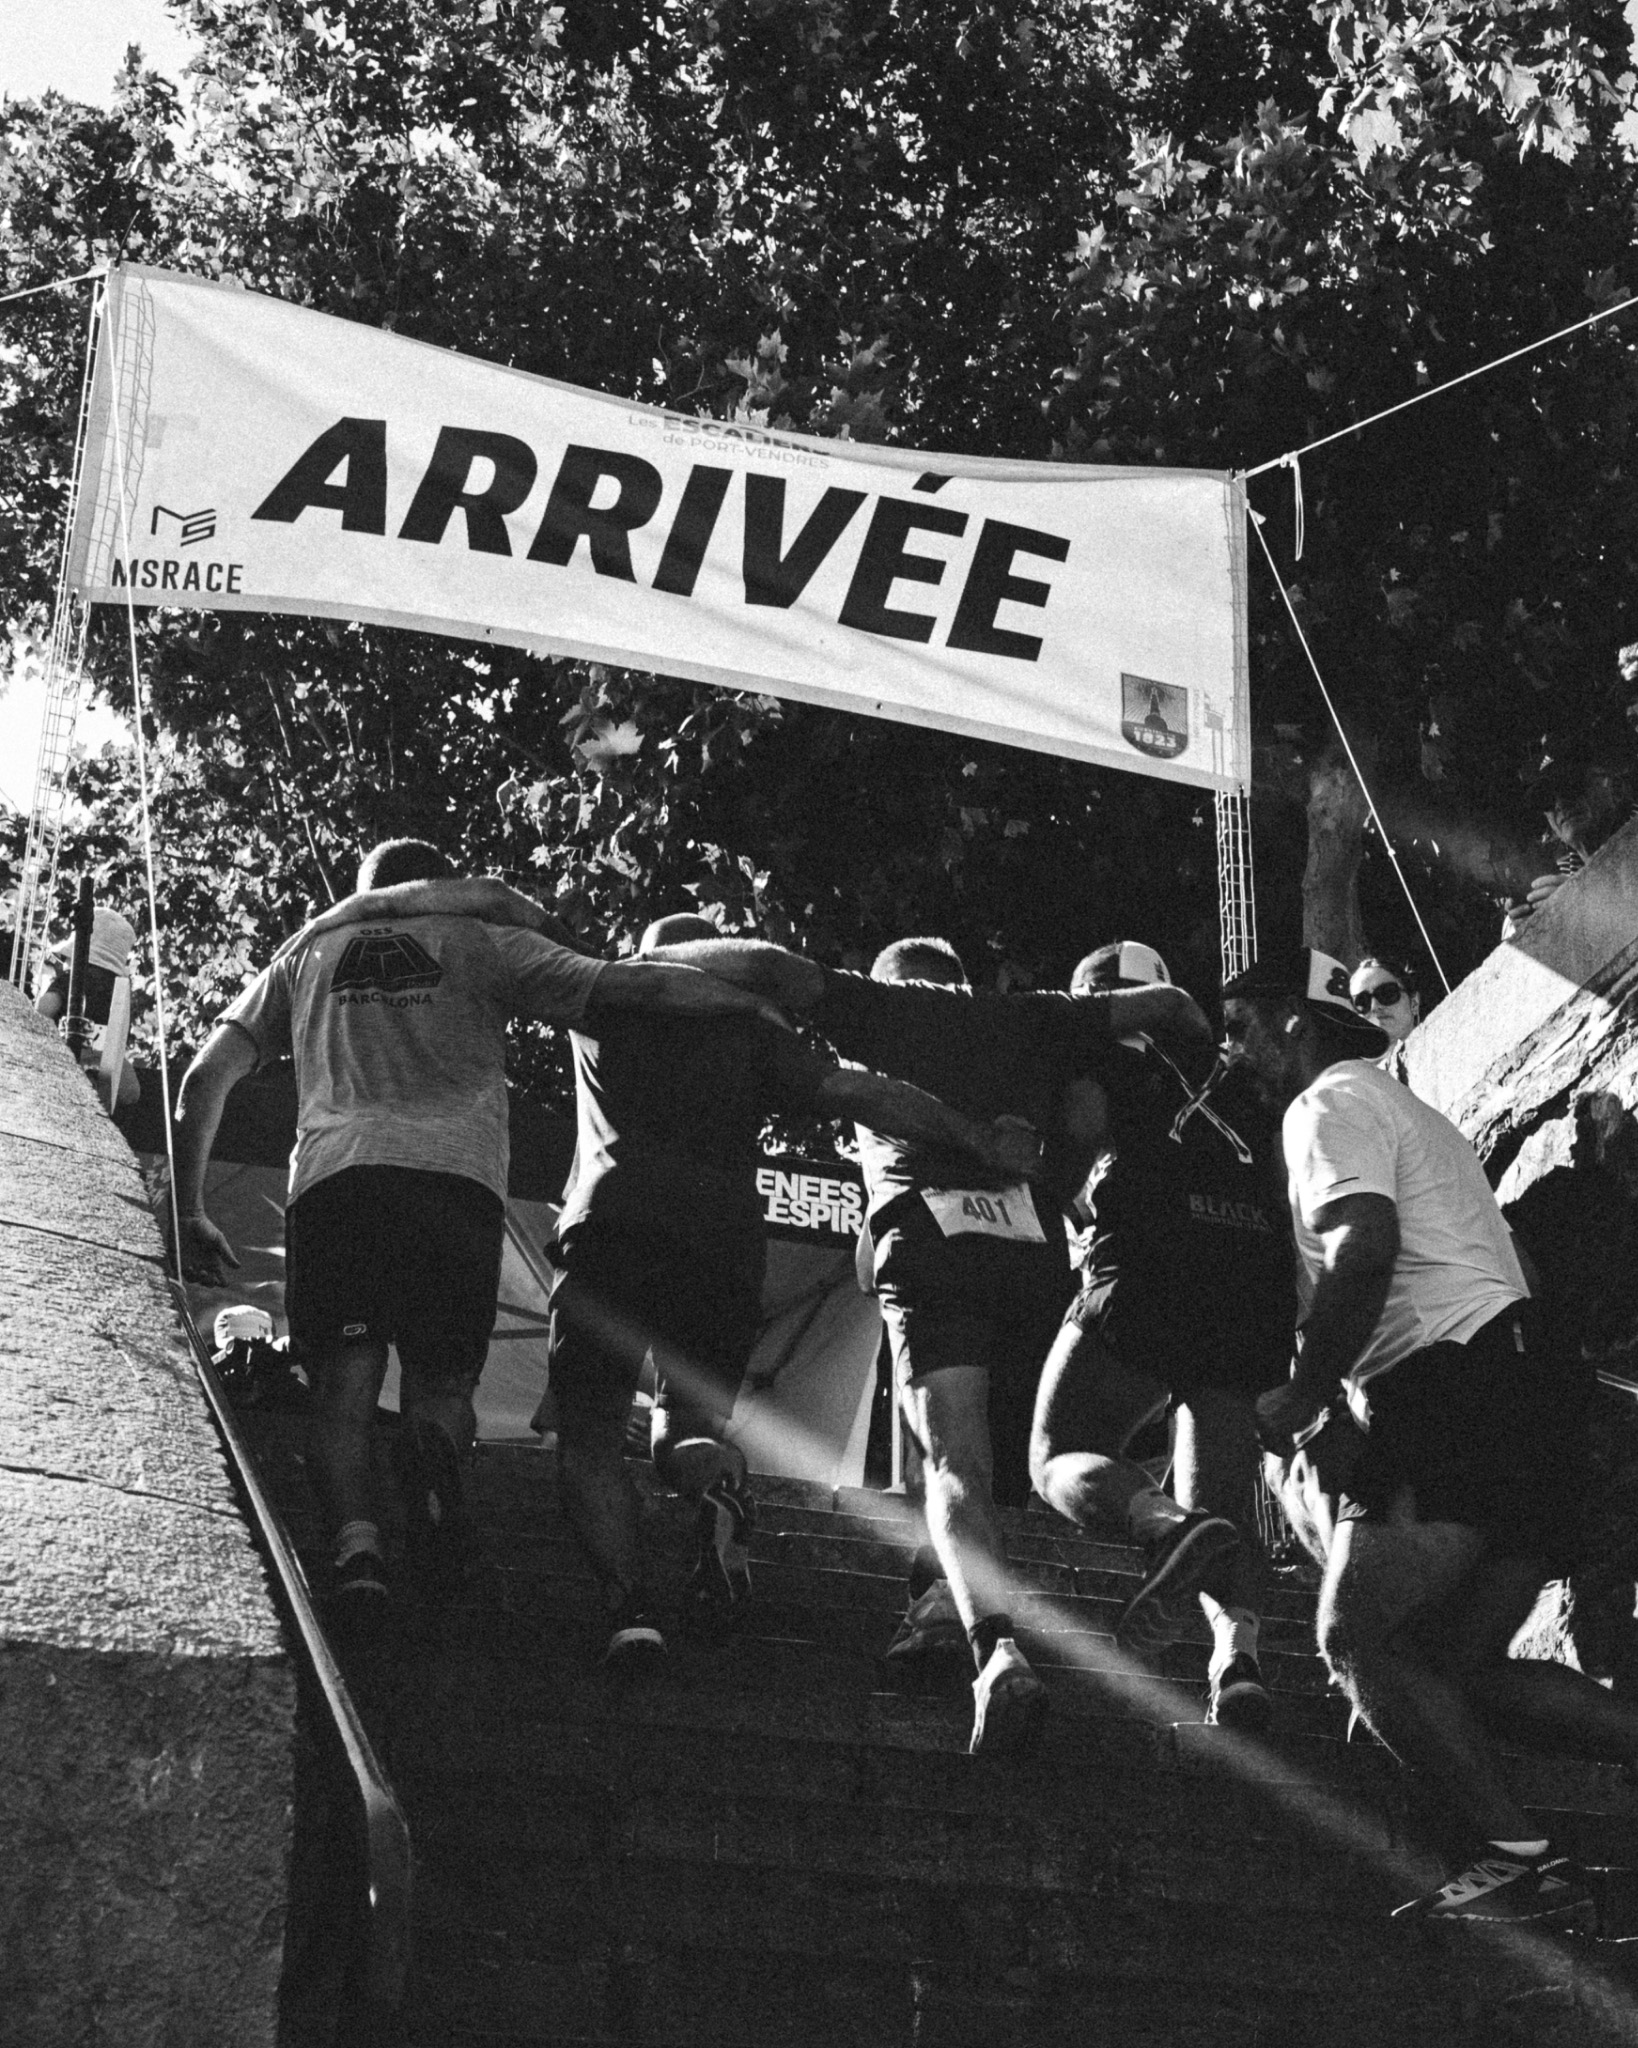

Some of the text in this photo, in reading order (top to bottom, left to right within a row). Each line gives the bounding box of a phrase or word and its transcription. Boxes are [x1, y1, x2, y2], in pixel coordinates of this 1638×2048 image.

[628, 415, 830, 456] Les ESCALIE
[663, 434, 830, 469] de PORT-VENDRES
[250, 416, 1072, 663] ARRIVÉE
[111, 558, 244, 595] MSRACE
[962, 1195, 1013, 1228] 401
[1188, 1193, 1269, 1226] BLACK
